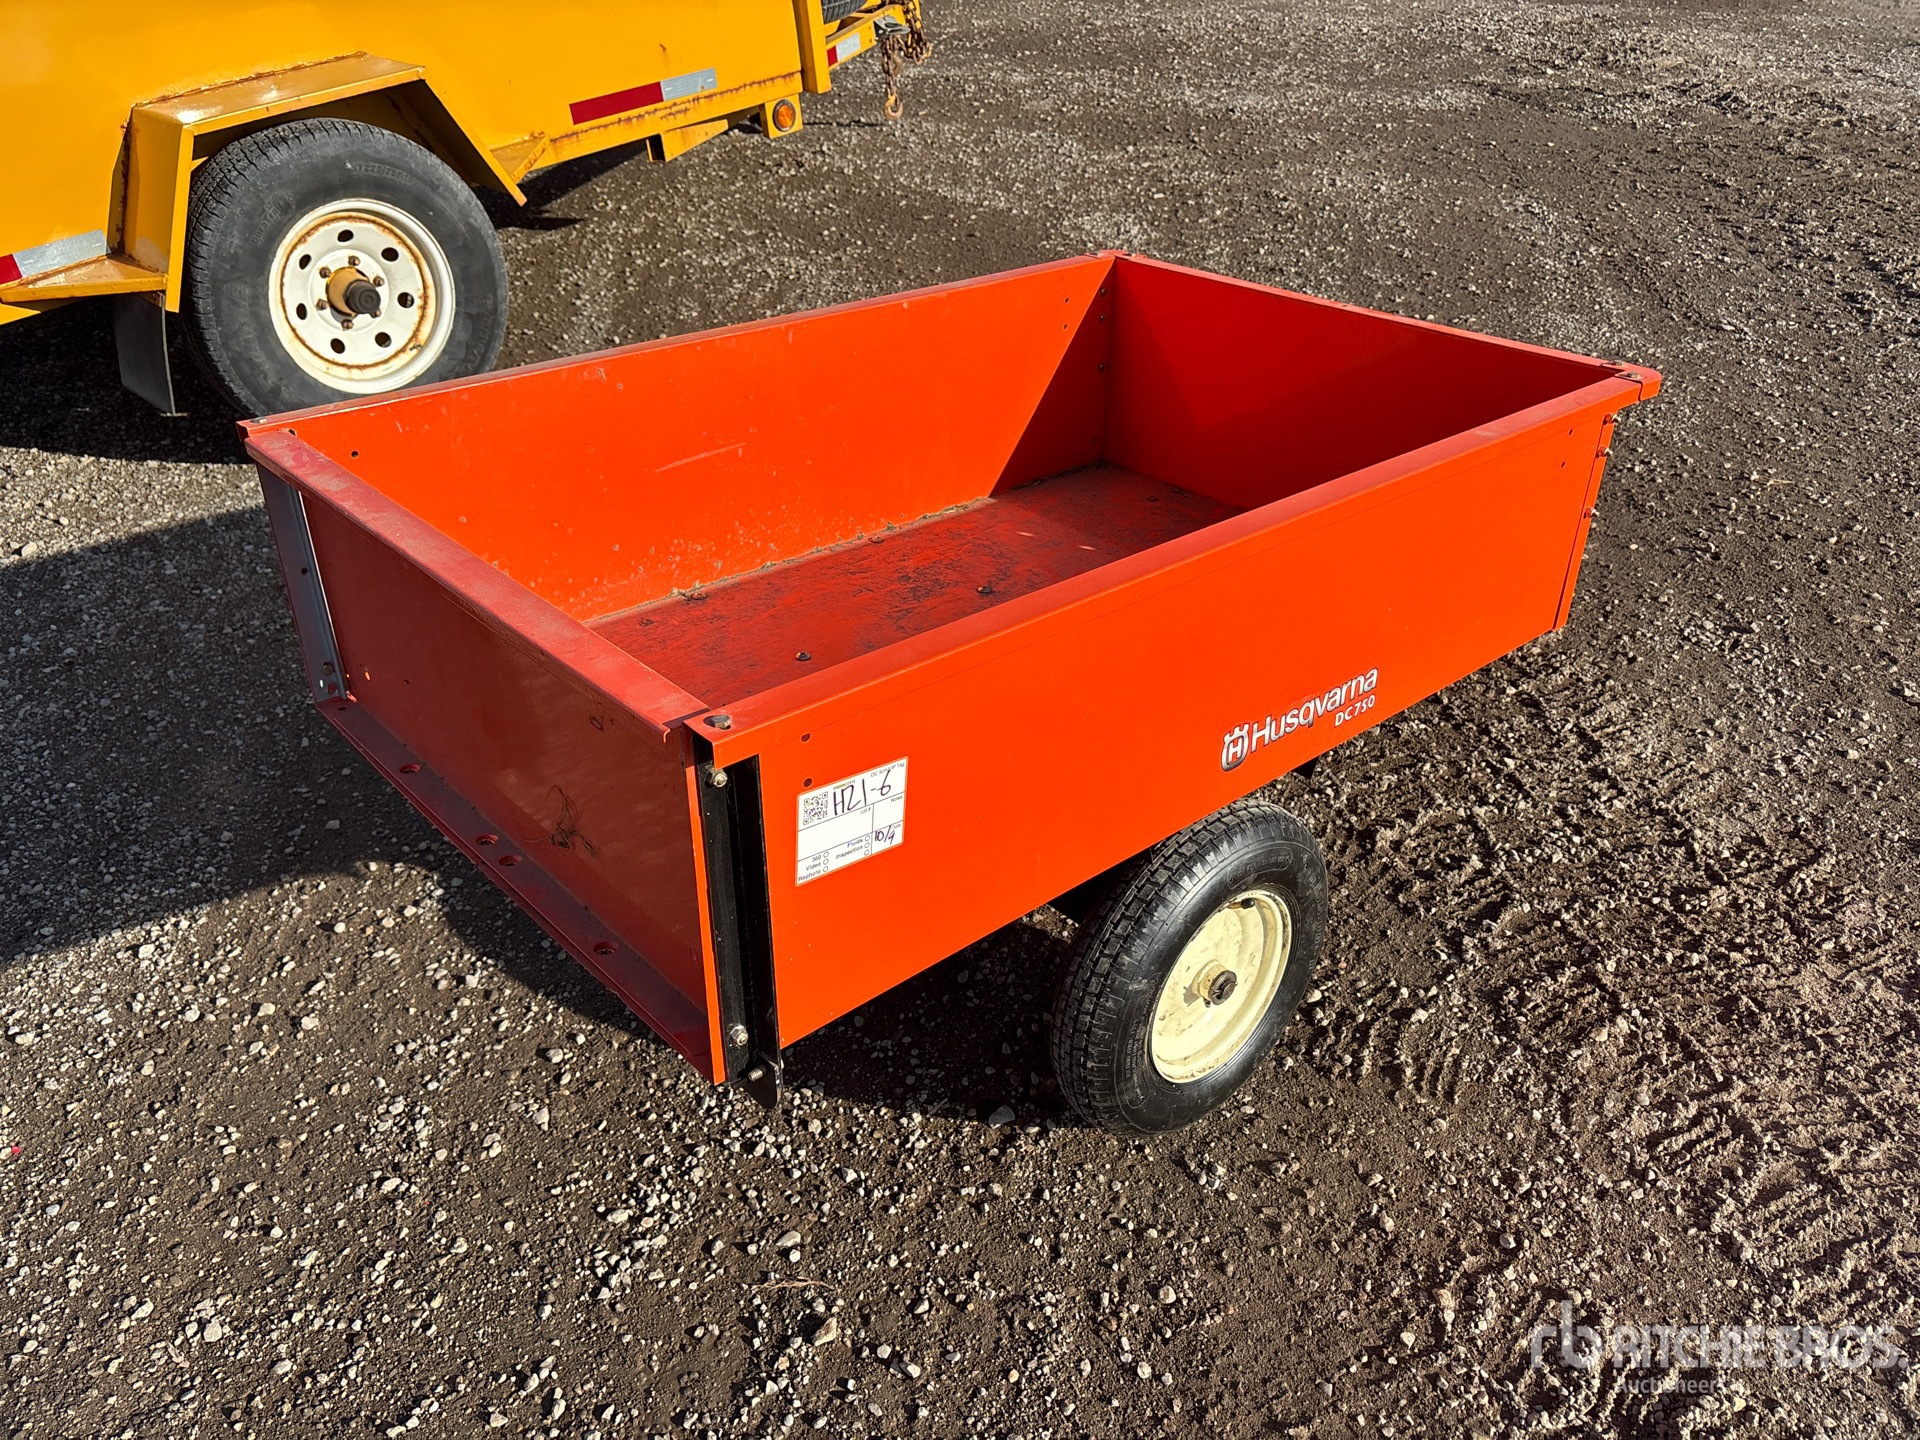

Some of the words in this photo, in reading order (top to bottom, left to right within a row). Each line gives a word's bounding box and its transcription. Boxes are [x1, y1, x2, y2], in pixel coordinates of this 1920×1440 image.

[1250, 667, 1379, 753] Husqvarna
[1335, 694, 1376, 727] DC750
[890, 795, 903, 803] Notes
[846, 839, 864, 848] Fluids
[835, 845, 864, 860] Inspection
[811, 854, 822, 863] 360
[805, 861, 822, 871] Video
[798, 869, 822, 882] Rephoto
